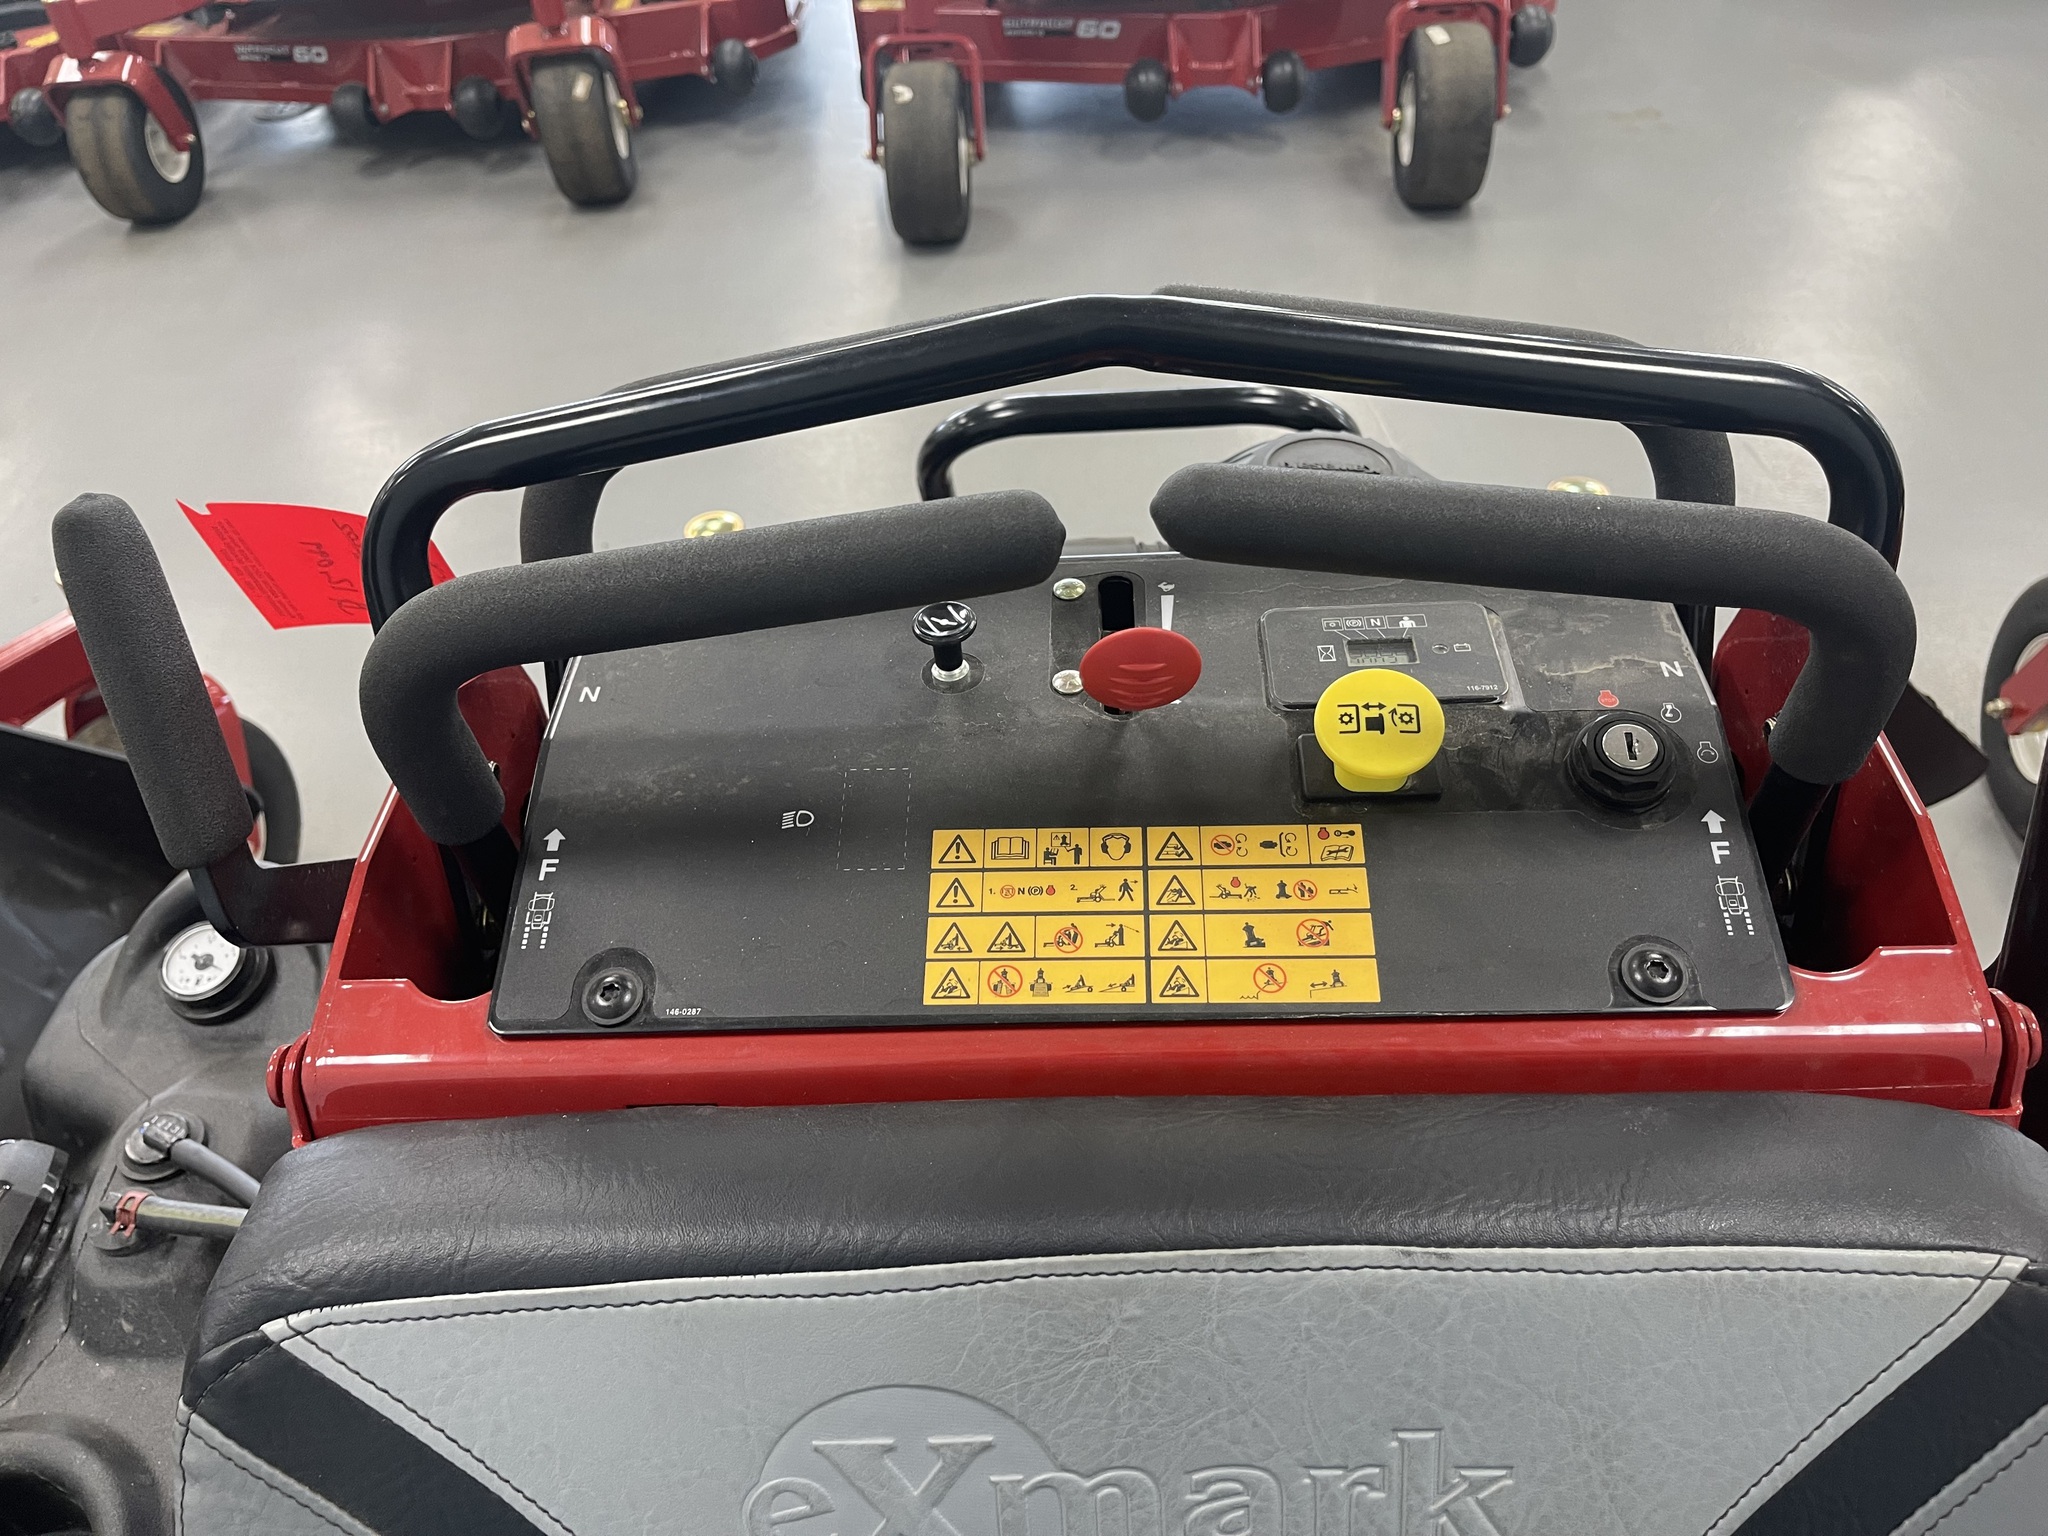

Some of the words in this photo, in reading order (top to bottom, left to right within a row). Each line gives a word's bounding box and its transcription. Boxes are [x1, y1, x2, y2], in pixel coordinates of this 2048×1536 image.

[1076, 20, 1121, 39] 60
[292, 46, 328, 63] 60
[1371, 618, 1381, 627] N
[1659, 661, 1684, 677] N
[579, 686, 601, 702] N
[1466, 684, 1499, 692] 116-7912
[1710, 841, 1730, 864] F
[538, 858, 560, 881] F
[1018, 887, 1025, 895] N
[665, 1007, 702, 1016] 146-0287
